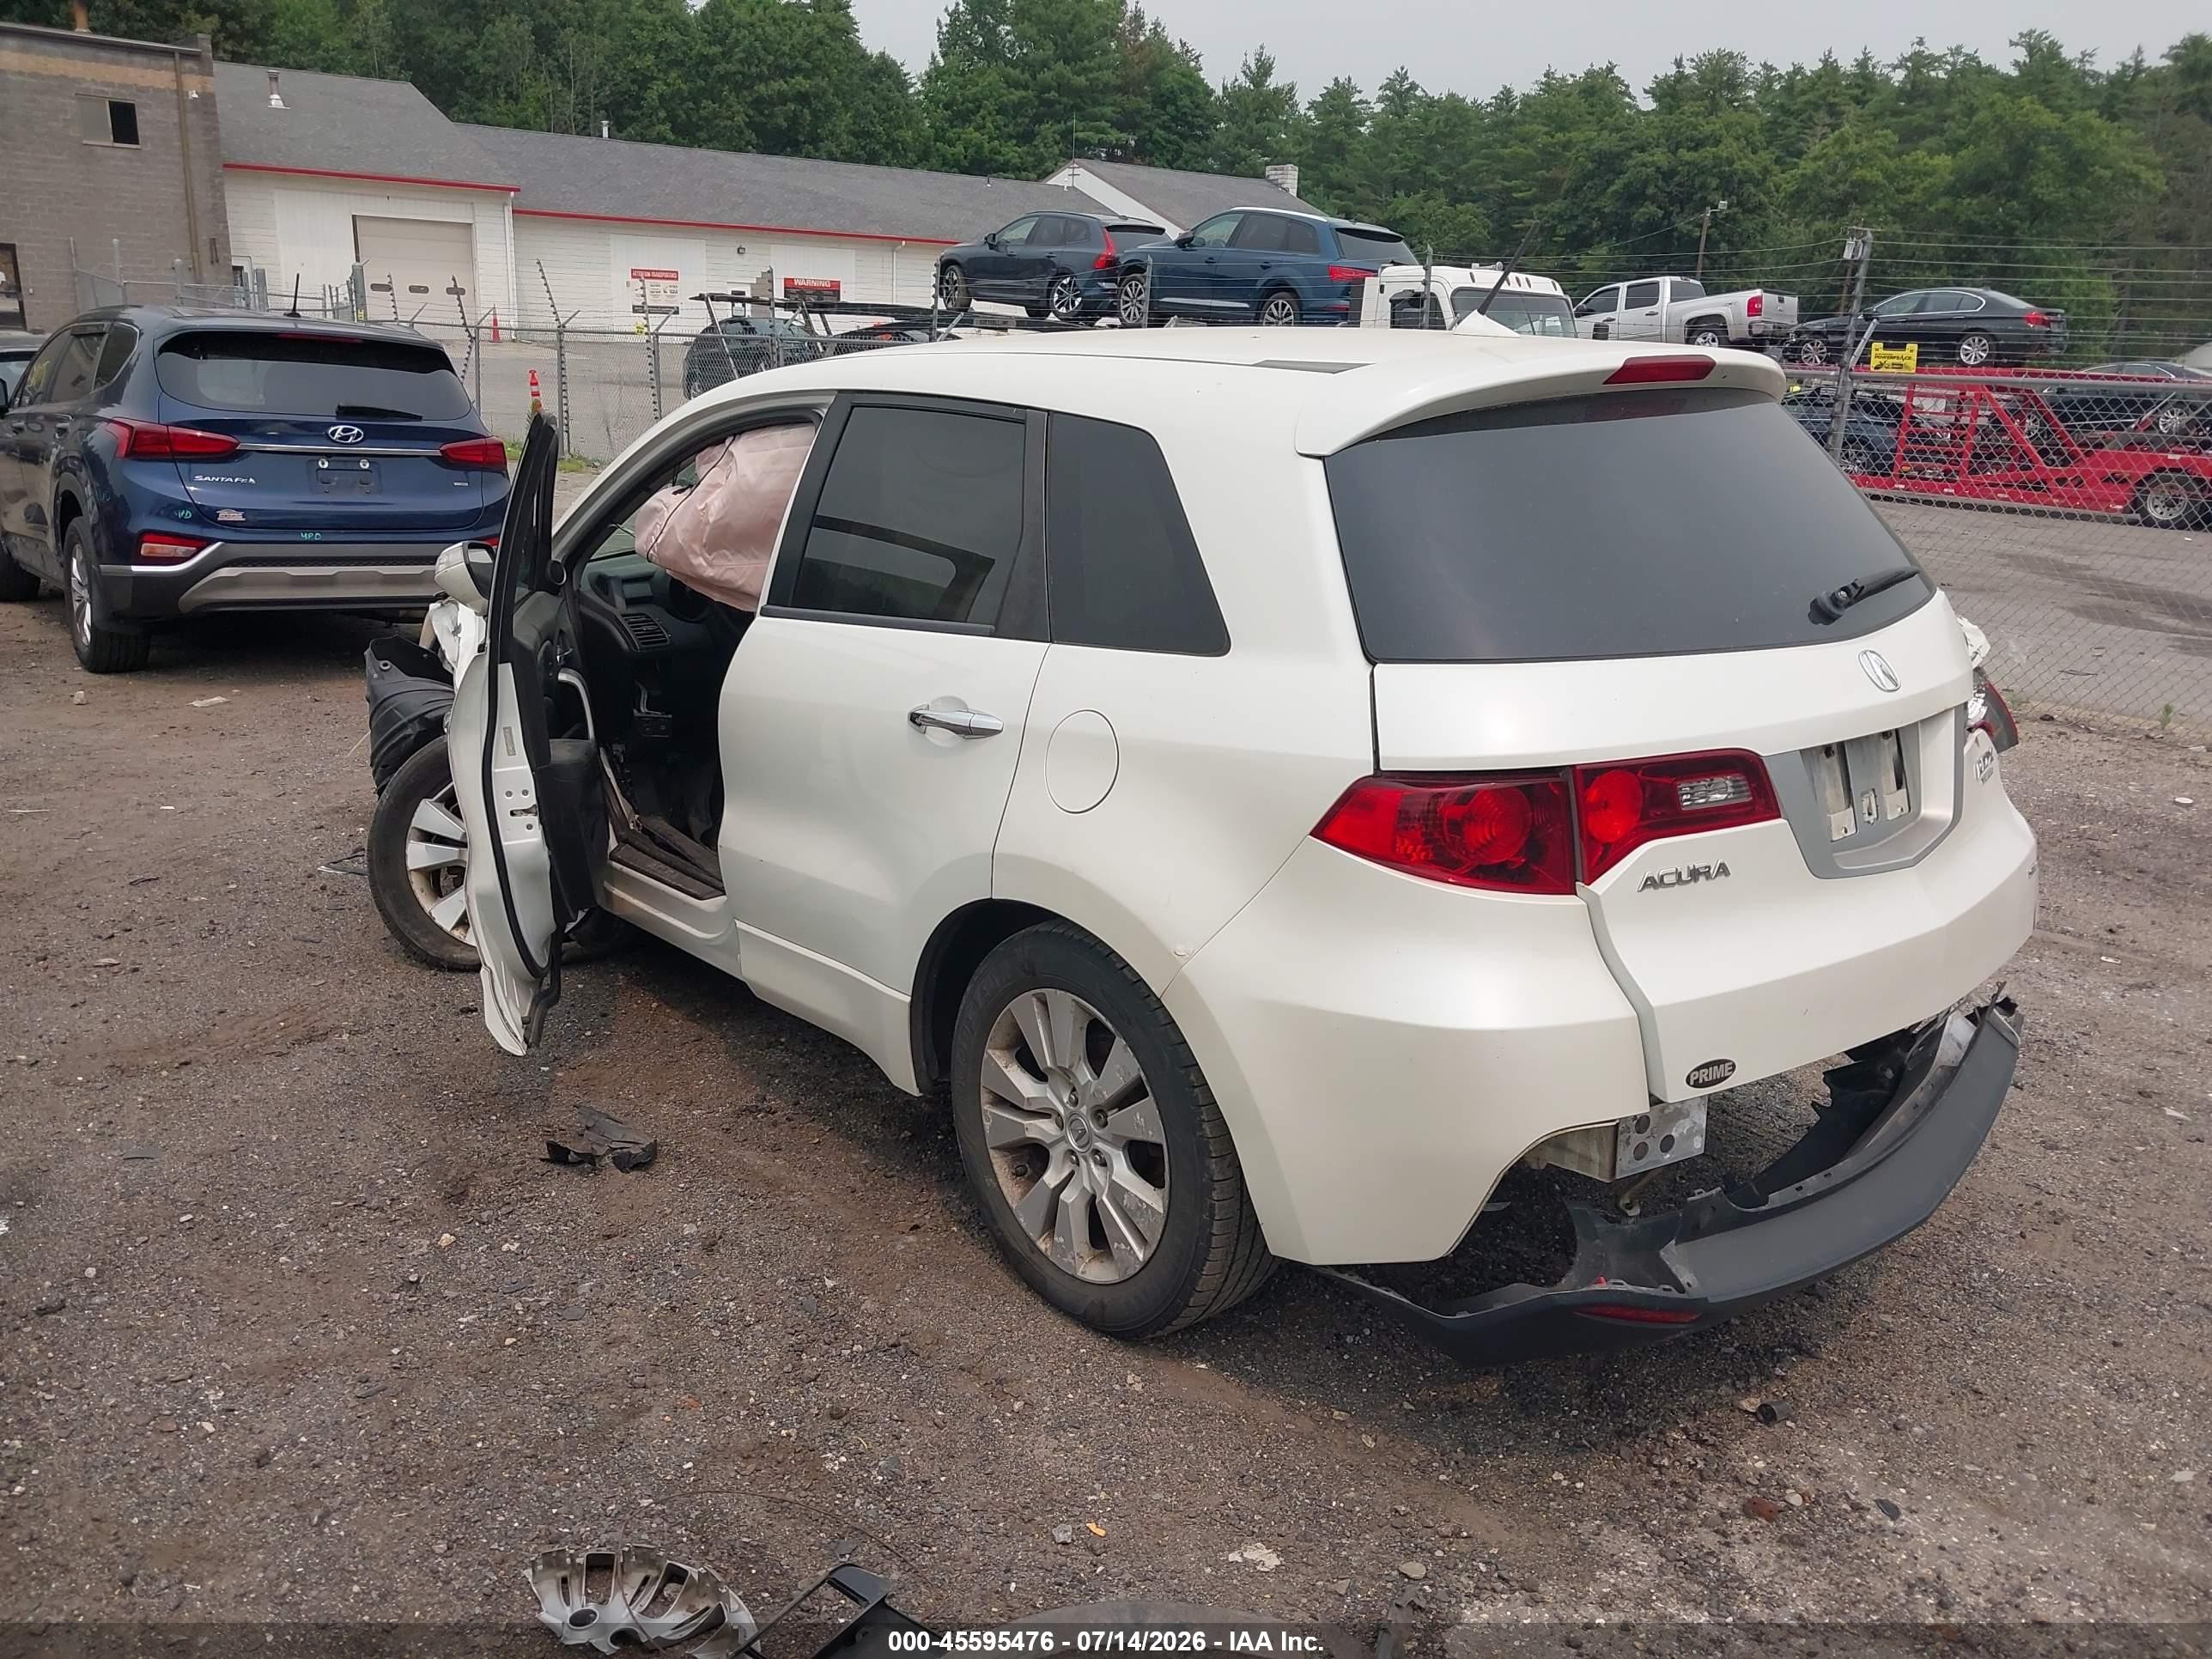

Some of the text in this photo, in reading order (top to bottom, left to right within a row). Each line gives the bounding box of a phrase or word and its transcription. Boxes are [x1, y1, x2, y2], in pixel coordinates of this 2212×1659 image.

[793, 278, 831, 288] WARNING
[1637, 859, 1732, 893] ACURA
[1689, 1061, 1734, 1086] PRIME
